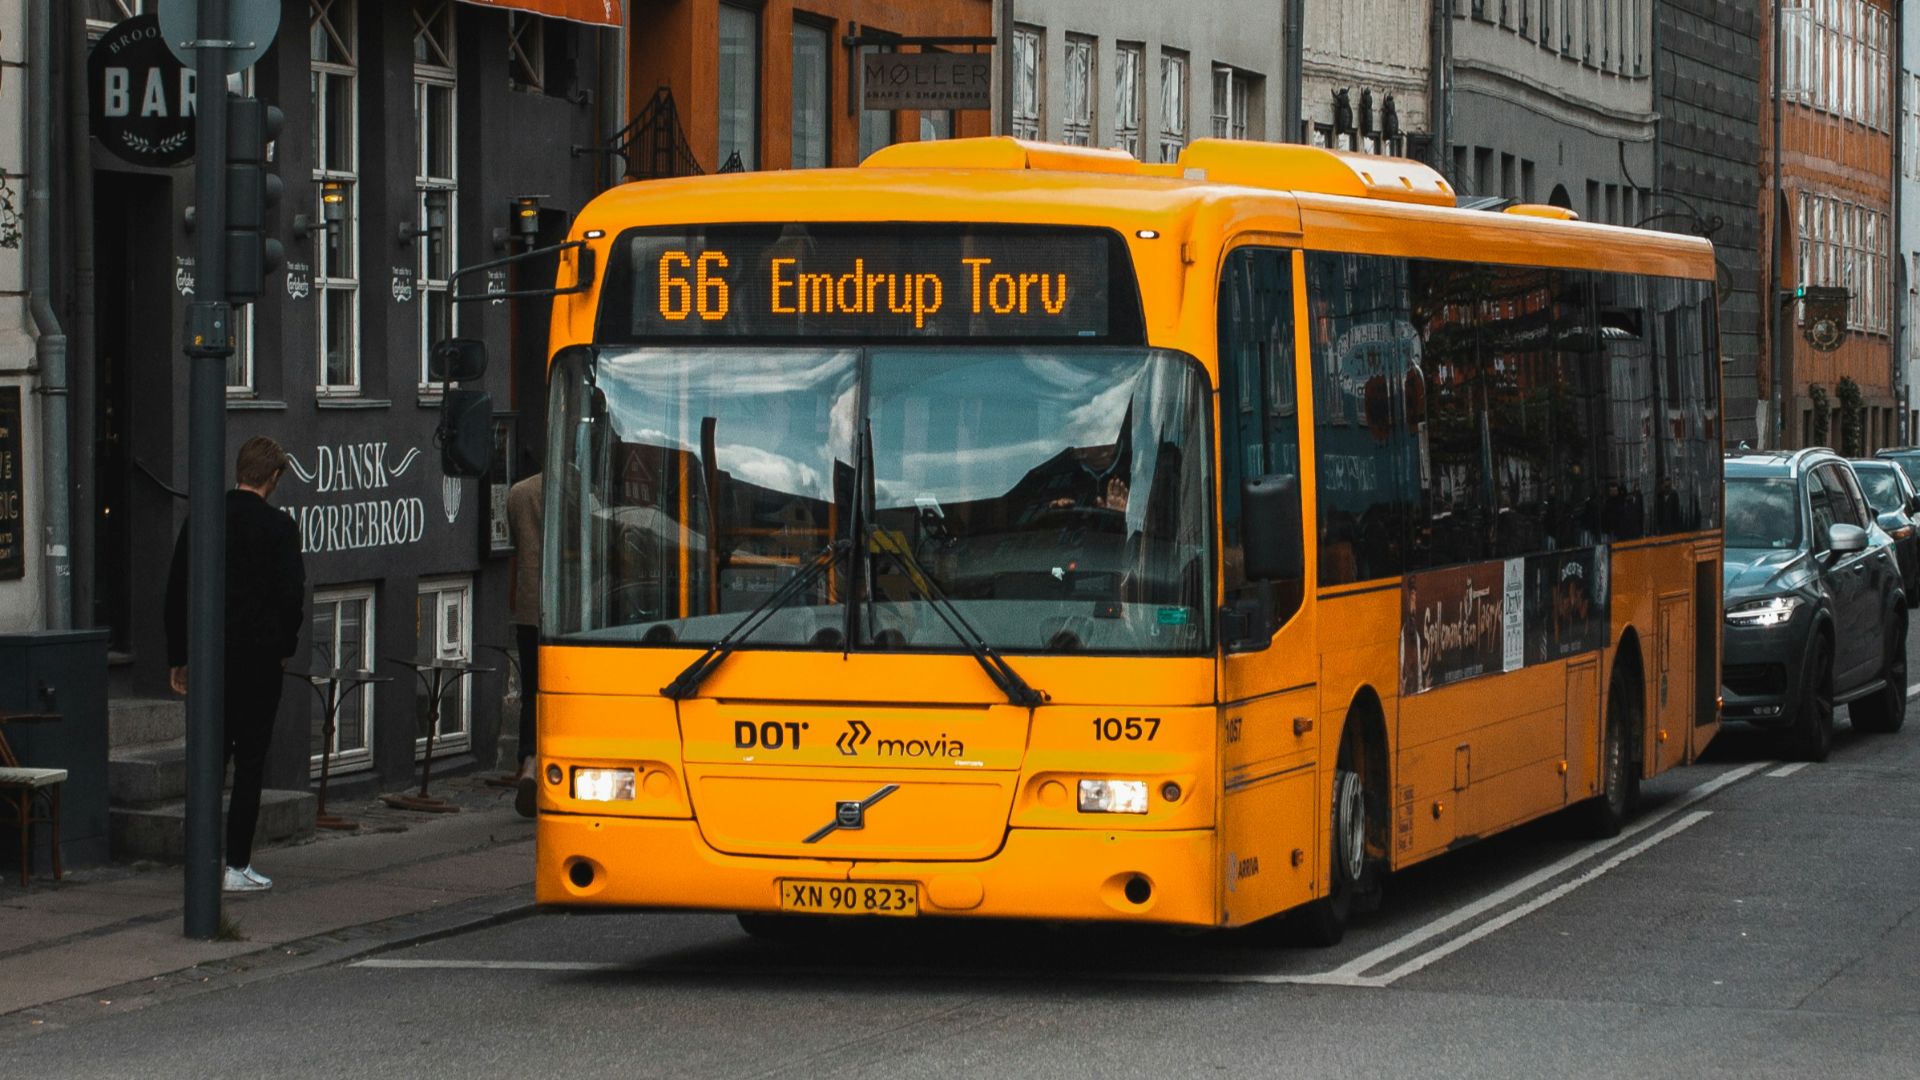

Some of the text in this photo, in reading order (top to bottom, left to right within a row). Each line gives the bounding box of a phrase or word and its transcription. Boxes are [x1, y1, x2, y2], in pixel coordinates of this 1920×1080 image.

[109, 26, 164, 54] BROO
[865, 63, 988, 86] MØLLER
[104, 66, 197, 118] BAR
[286, 272, 309, 300] Carlsberg
[391, 276, 412, 303] Carlsberg
[659, 251, 1067, 328] 66 Emdrup Torv
[316, 442, 389, 493] DANSK
[280, 497, 425, 553] MØRREBRØD
[734, 720, 809, 750] DOT
[1092, 717, 1161, 741] 1057
[877, 733, 964, 758] movia
[792, 885, 907, 911] XN 90 823
